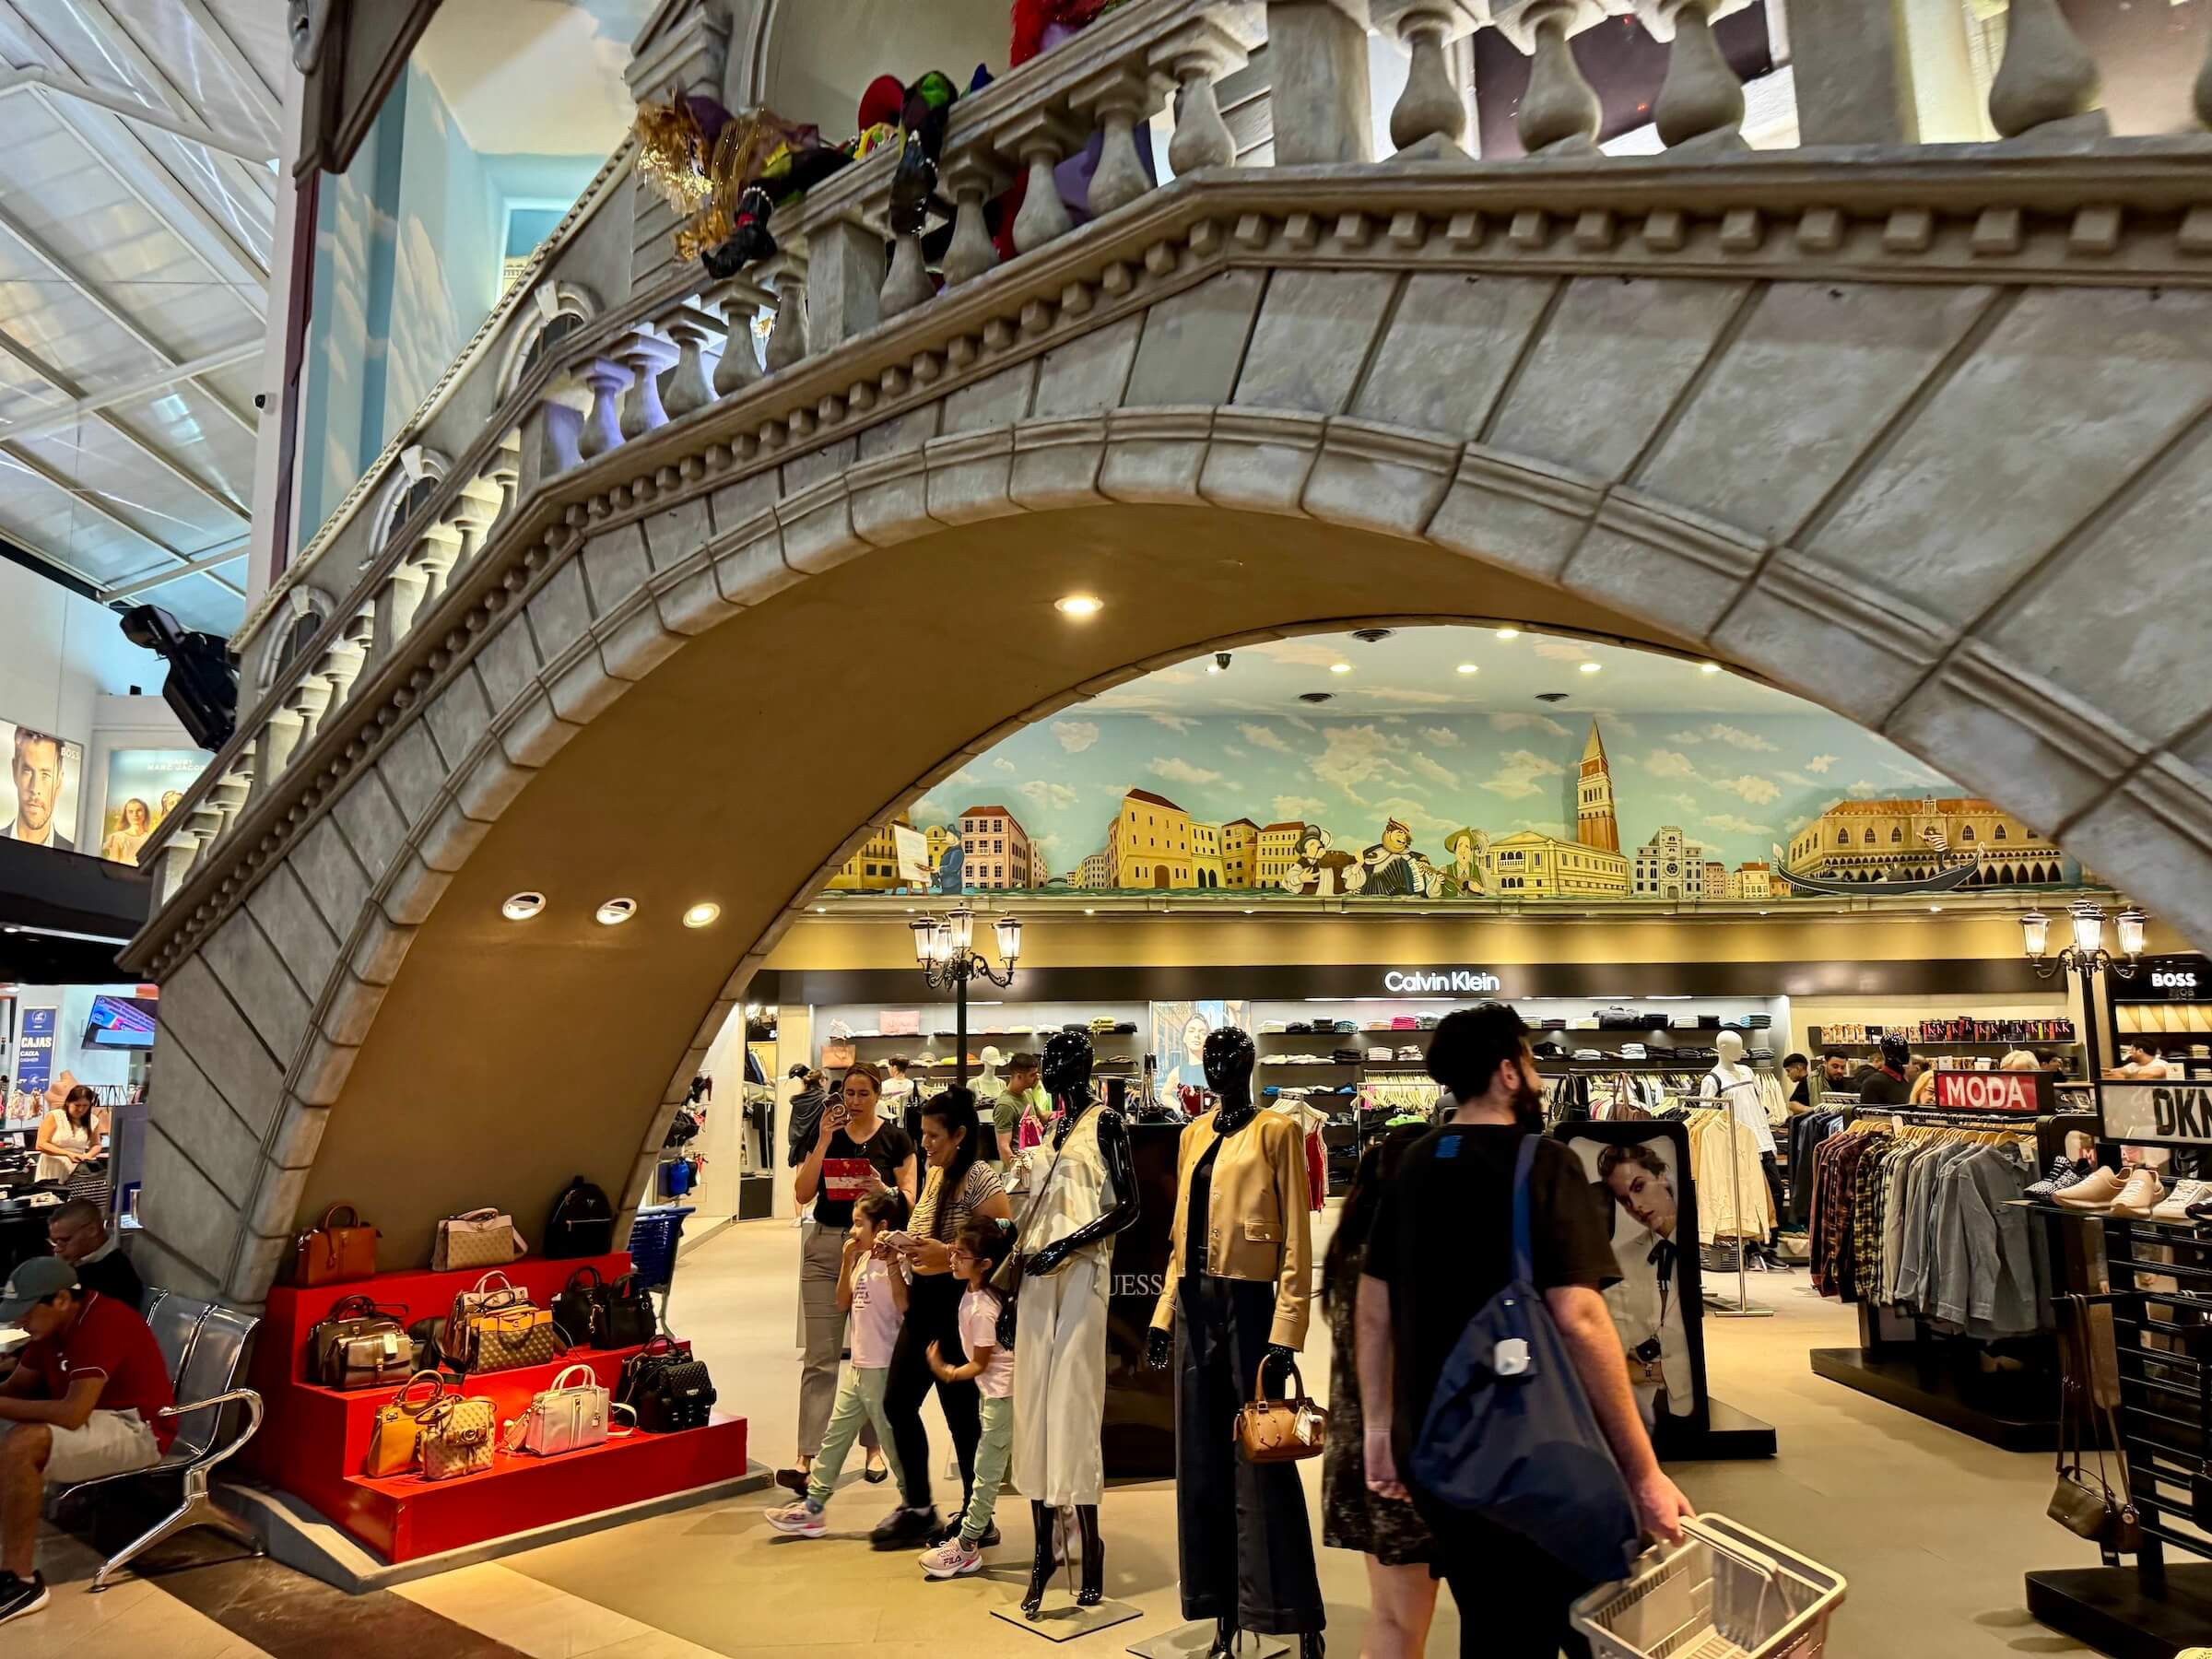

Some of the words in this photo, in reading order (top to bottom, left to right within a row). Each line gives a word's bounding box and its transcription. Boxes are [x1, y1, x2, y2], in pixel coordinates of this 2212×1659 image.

[1384, 971, 1450, 992] Calvin
[1451, 971, 1500, 992] Klein
[2151, 972, 2197, 987] BOSS
[21, 1037, 53, 1048] CAJAS
[1946, 1076, 2027, 1108] MODA
